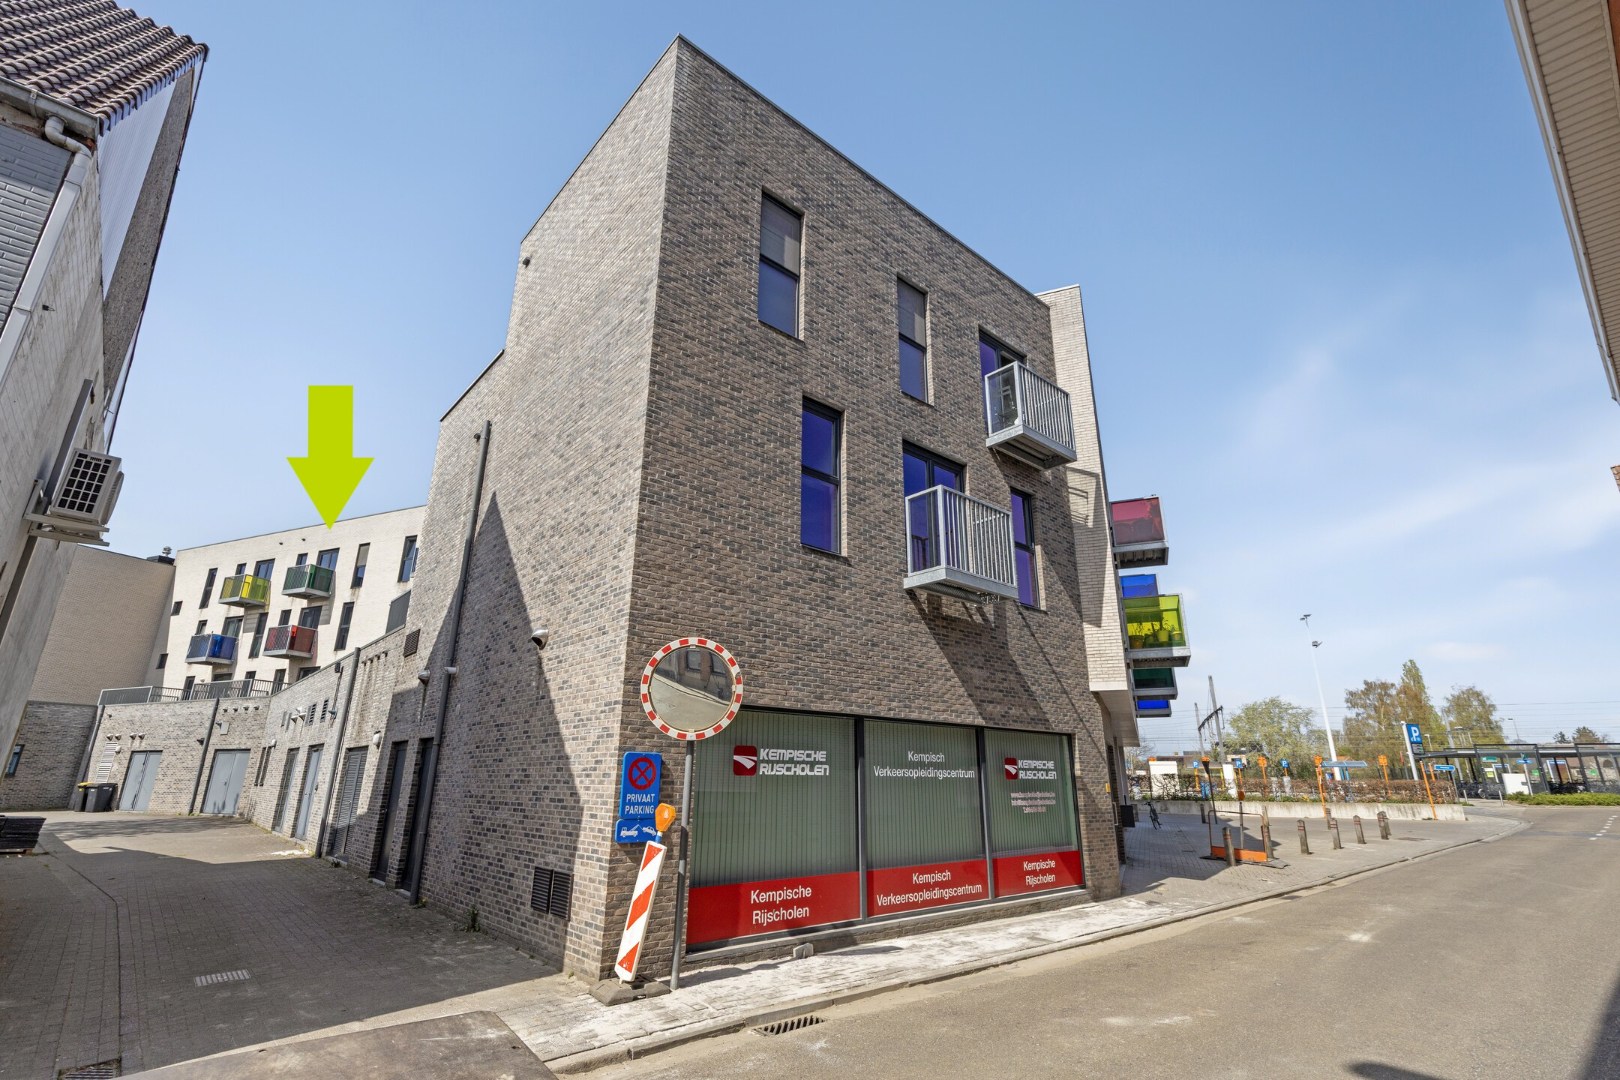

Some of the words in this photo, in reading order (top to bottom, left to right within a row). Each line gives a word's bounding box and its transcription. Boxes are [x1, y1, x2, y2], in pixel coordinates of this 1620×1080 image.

[760, 748, 826, 762] KEMPISCHE
[908, 750, 945, 763] Kempisch
[759, 763, 830, 776] RIJSCHOLEN
[1018, 759, 1054, 770] KEMPISCHE
[873, 766, 975, 780] Verkeersopleidingscentrum
[626, 794, 656, 803] PRIVAAT
[624, 805, 654, 815] PARKING
[1023, 860, 1056, 871] Kempische
[912, 870, 951, 884] Kempisch
[1026, 873, 1056, 886] Rijscholen
[750, 885, 812, 904] Kempische
[876, 883, 982, 906] Verkeersopleidingscentrum
[752, 906, 810, 926] Rijscholen
